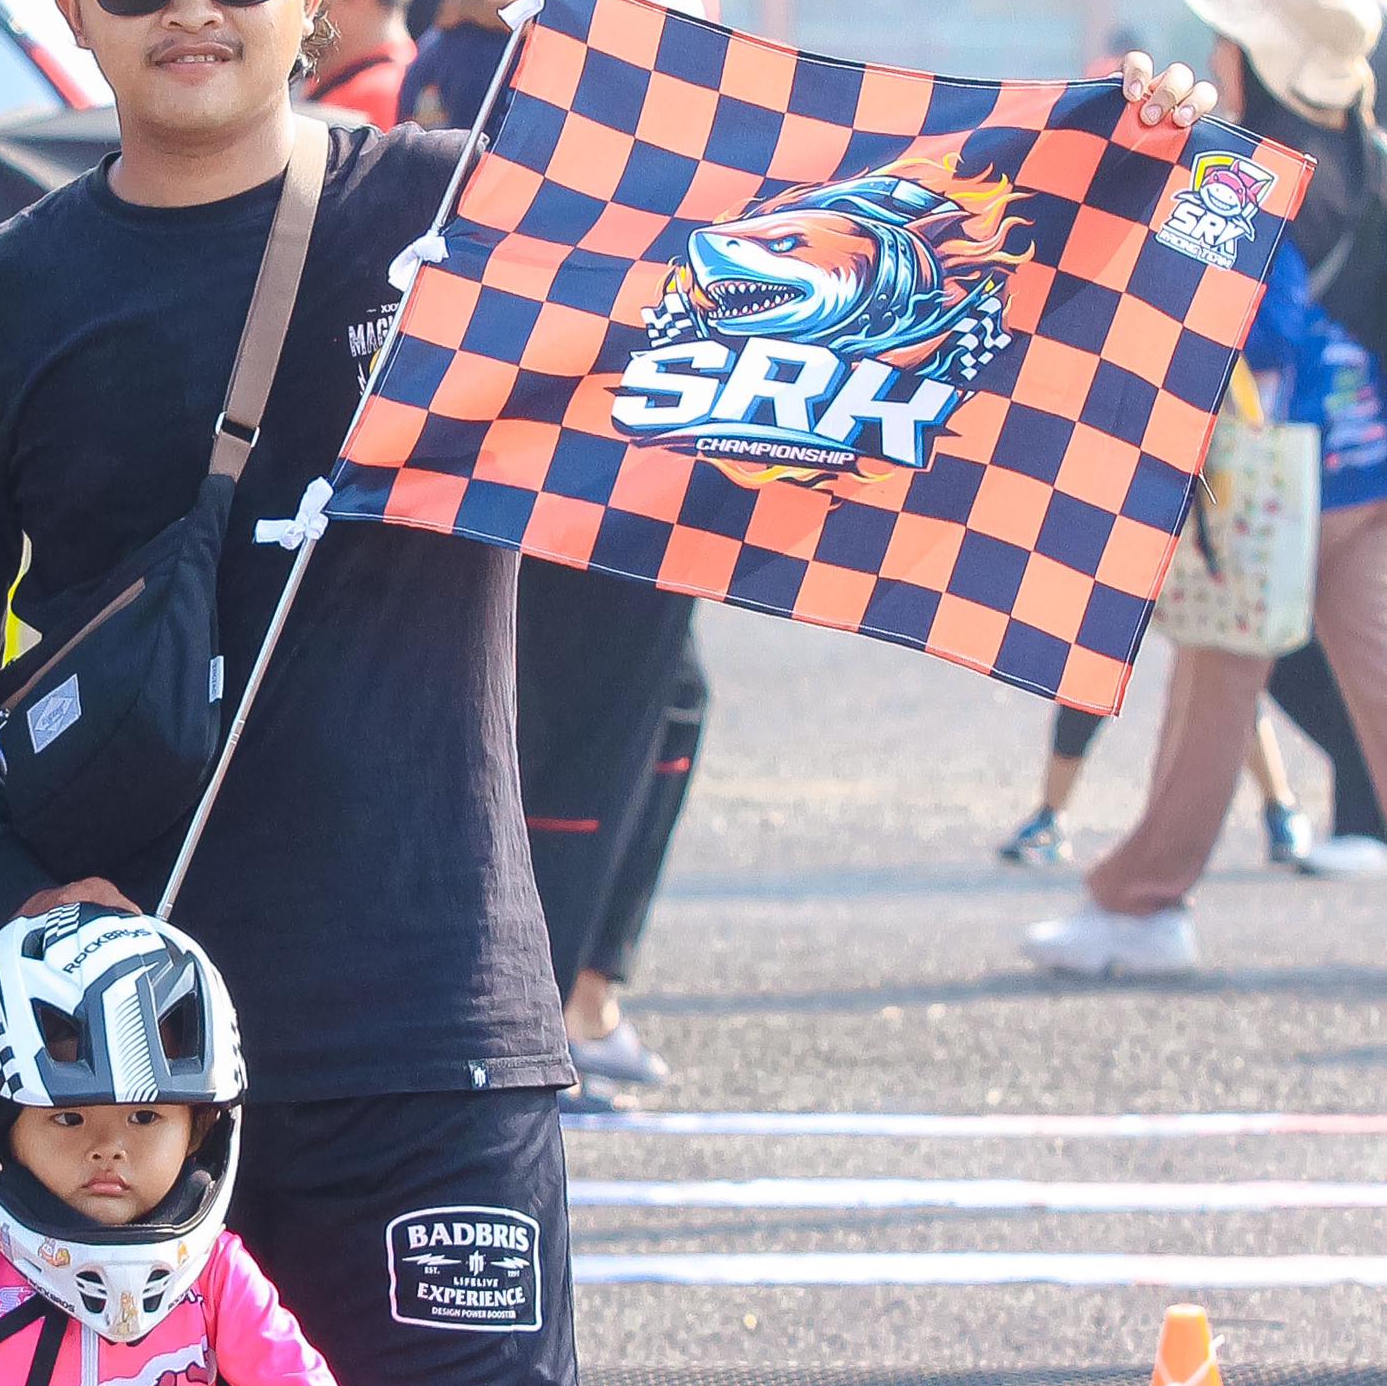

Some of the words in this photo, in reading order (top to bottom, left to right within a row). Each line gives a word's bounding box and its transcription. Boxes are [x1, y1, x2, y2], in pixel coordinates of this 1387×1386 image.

[612, 337, 957, 467] SRK
[696, 438, 855, 465] CHAMPIONSHIP
[63, 928, 152, 974] ROCKBROS
[407, 1223, 530, 1252] BADBRIS
[424, 1266, 441, 1275] EST.
[453, 1276, 499, 1288] LIFELIVE
[417, 1282, 526, 1307] EXPERIENCE
[431, 1306, 461, 1318] DESIGN
[461, 1310, 486, 1319] POWER
[487, 1310, 517, 1320] BOOSTER
